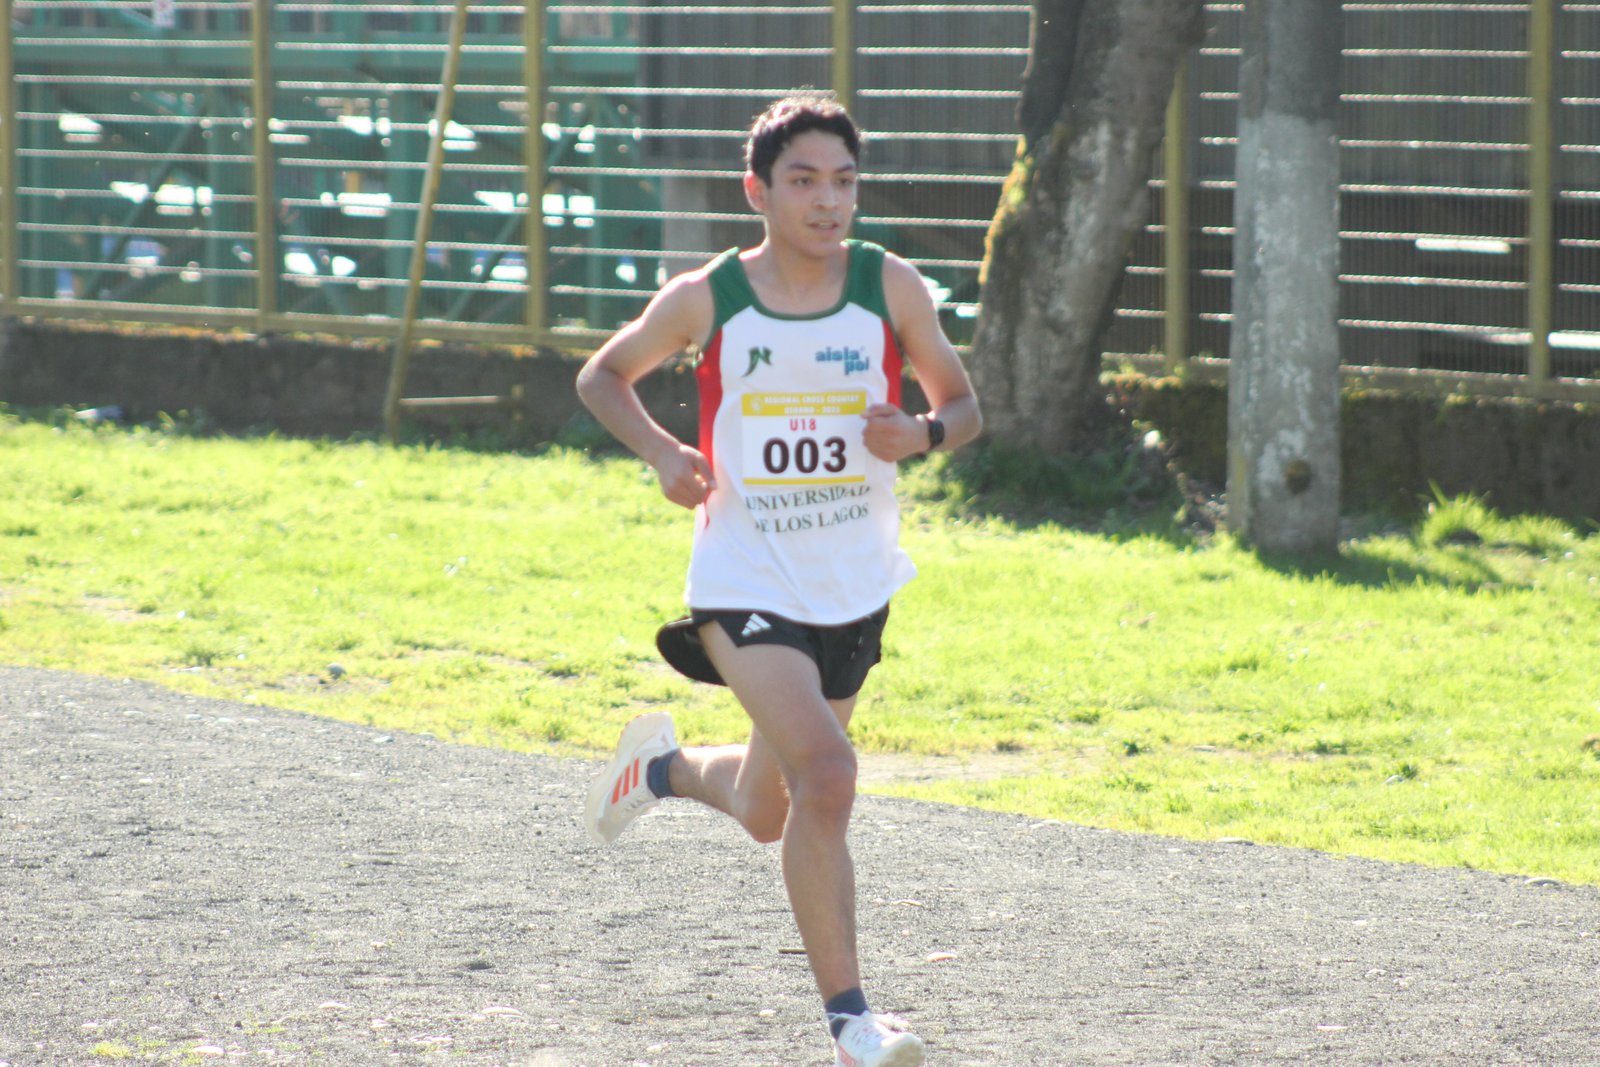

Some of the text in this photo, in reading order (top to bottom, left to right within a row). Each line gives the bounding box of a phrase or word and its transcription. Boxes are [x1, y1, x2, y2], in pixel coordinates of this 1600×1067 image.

[789, 418, 817, 431] U18
[763, 436, 847, 474] 003
[745, 485, 871, 511] UNIVERSIDAD
[774, 514, 813, 533] LOS
[817, 502, 869, 528] LAGOS
